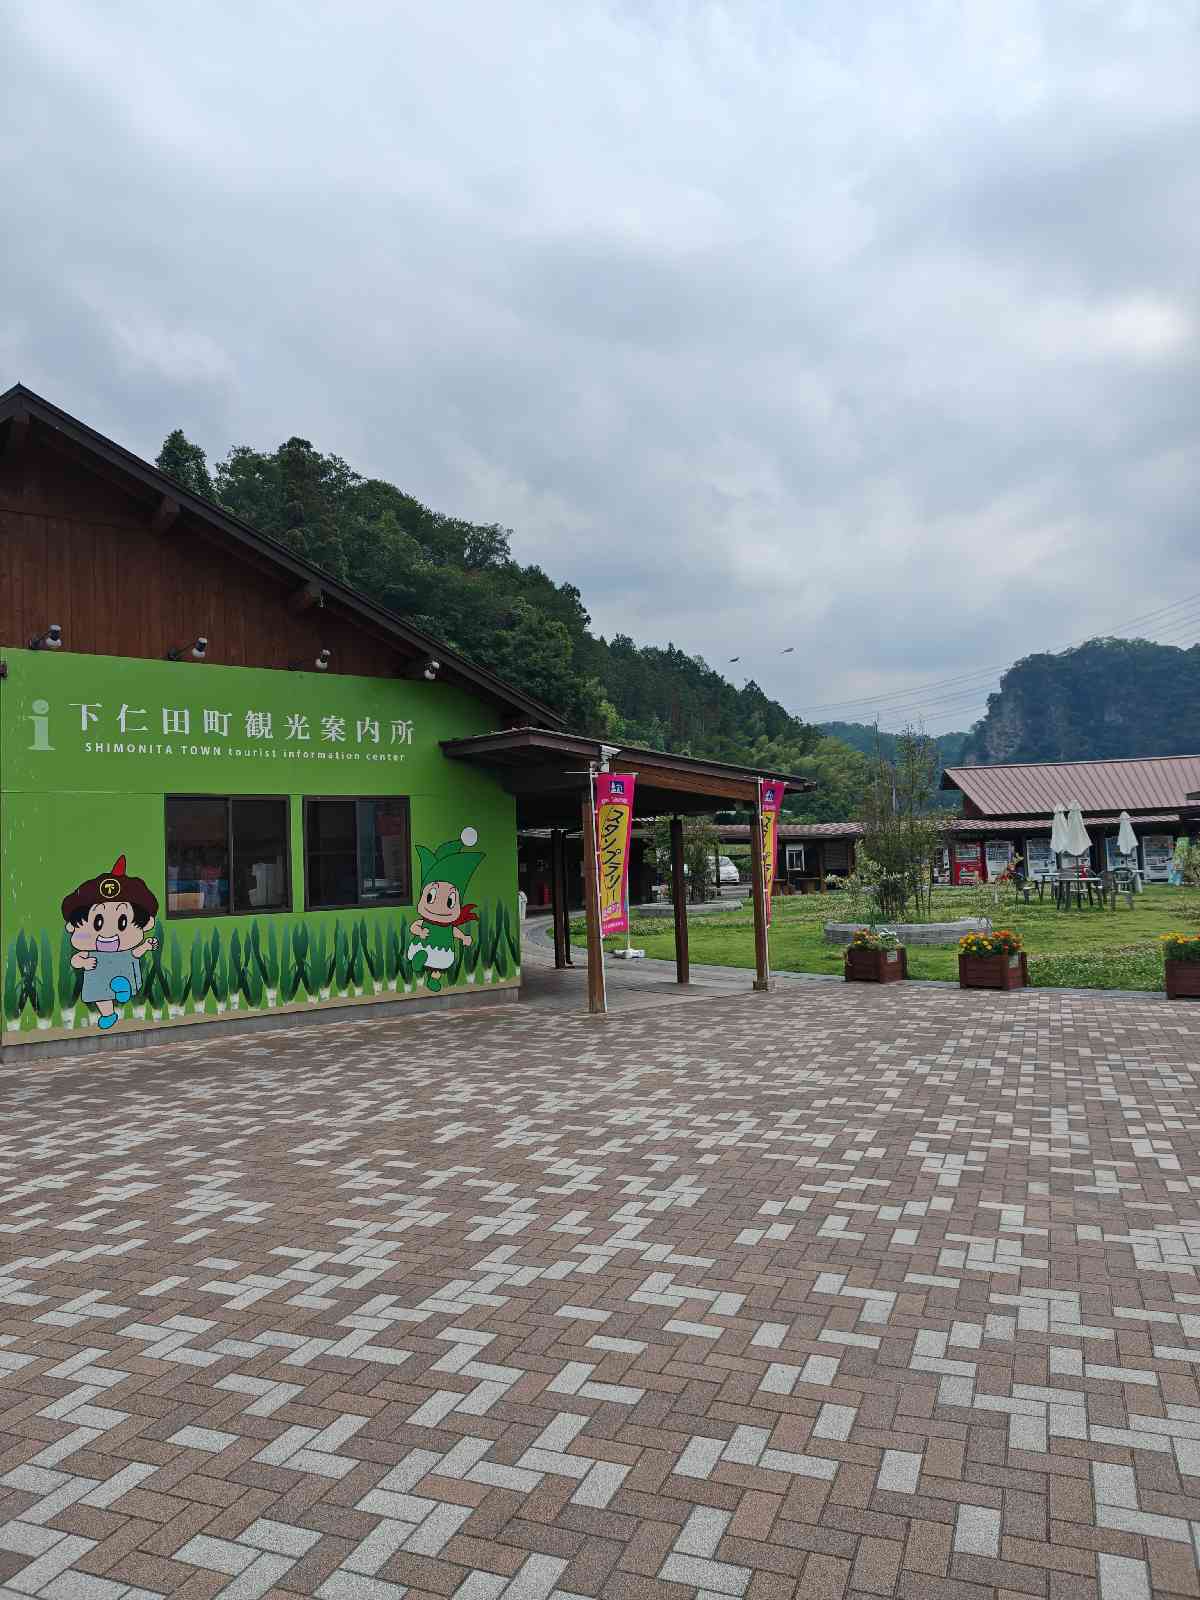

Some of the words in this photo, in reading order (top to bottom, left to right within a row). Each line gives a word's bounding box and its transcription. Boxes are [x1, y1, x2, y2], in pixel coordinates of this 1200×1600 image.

[68, 703, 416, 745] 下仁田町観光案内所
[85, 742, 173, 754] SHIMONITA
[180, 745, 221, 756] TOWN
[228, 748, 276, 758] tourist
[283, 749, 361, 761] information
[365, 753, 405, 762] center
[601, 808, 625, 901] スタンプラリー
